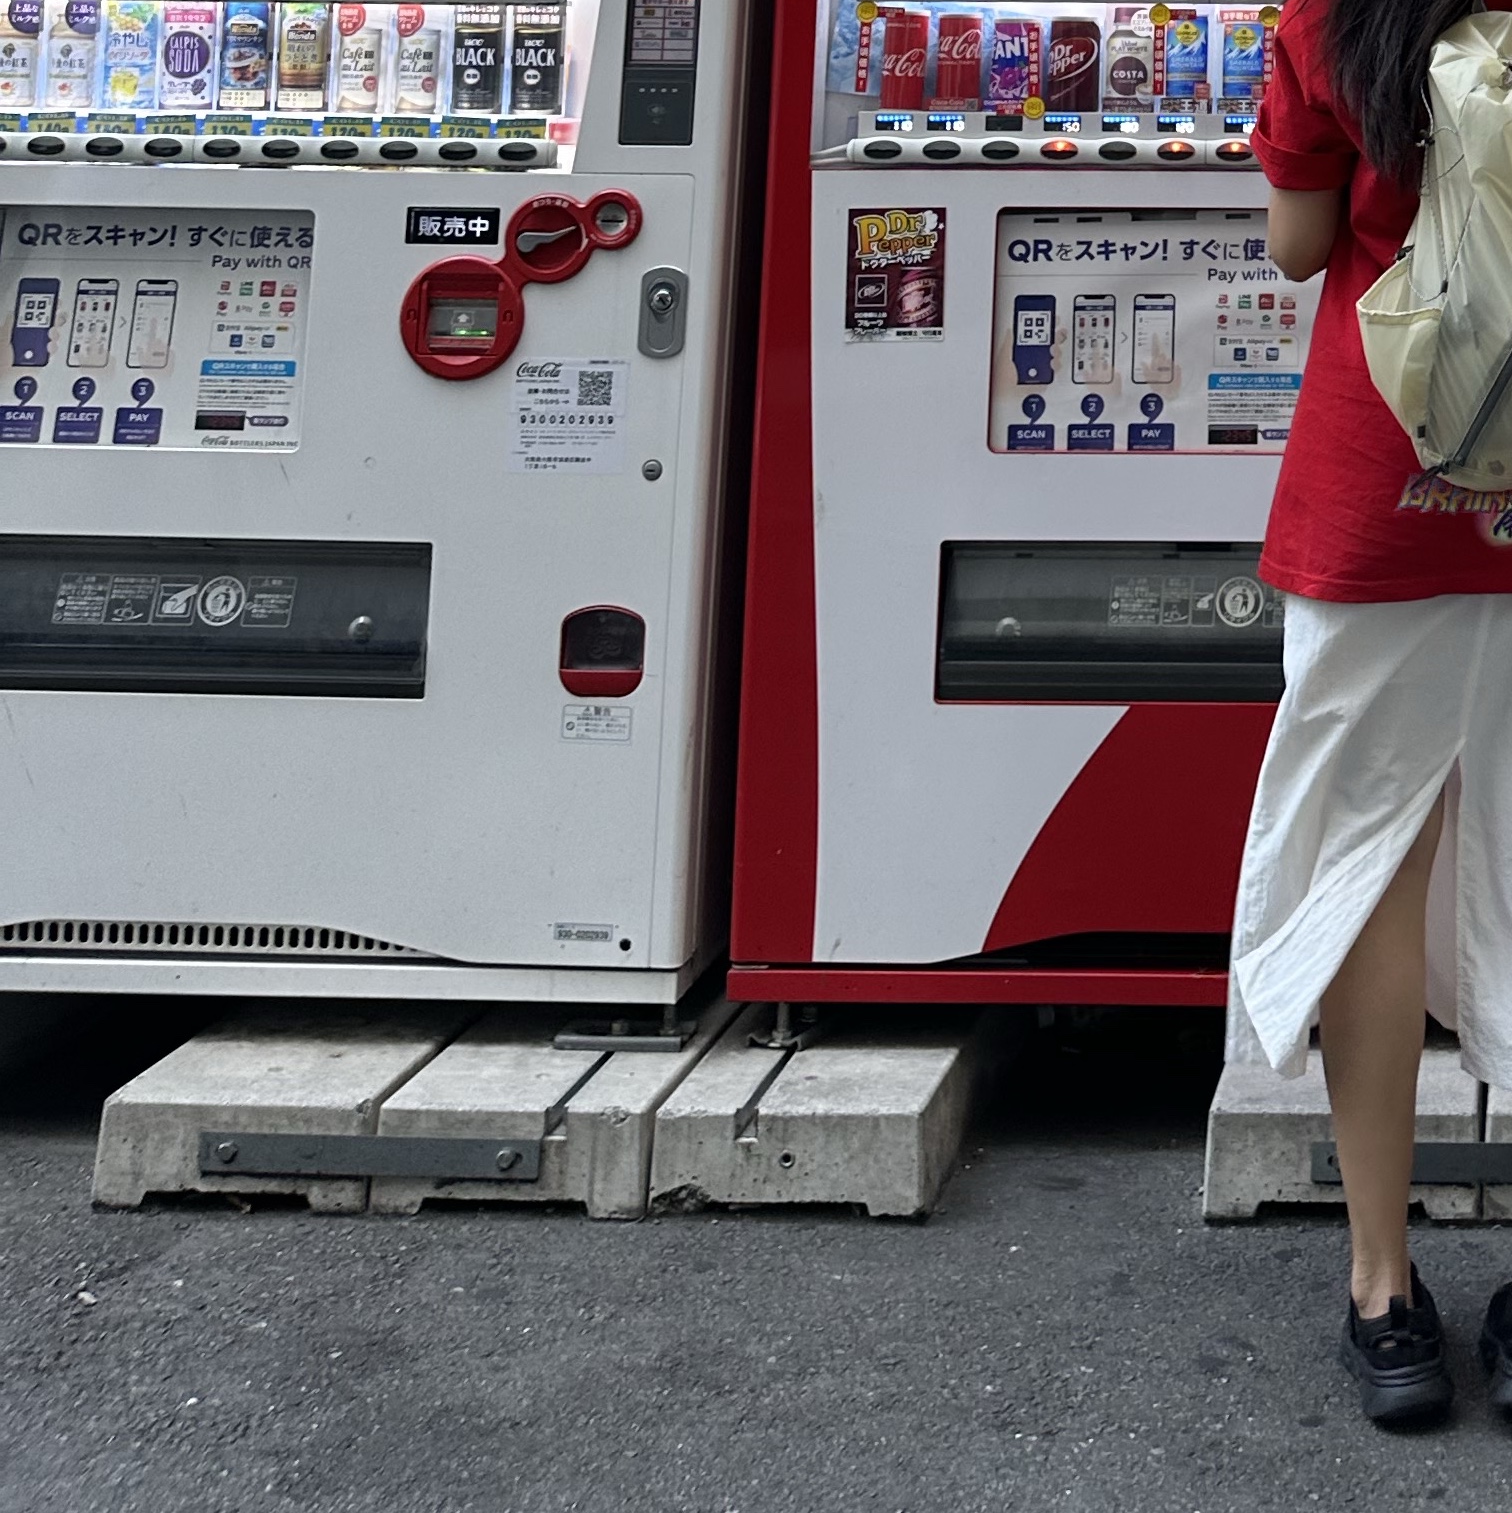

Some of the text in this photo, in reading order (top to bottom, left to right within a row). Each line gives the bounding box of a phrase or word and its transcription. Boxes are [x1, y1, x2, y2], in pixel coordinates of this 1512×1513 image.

[110, 33, 149, 48] 冷やし
[169, 37, 200, 50] CALPIS
[342, 48, 363, 61] Café
[456, 48, 495, 66] BLACK
[515, 48, 556, 67] BLACK
[1053, 43, 1073, 59] Dr
[169, 50, 200, 73] SODA
[1112, 70, 1144, 79] COSTA
[418, 216, 490, 237] 販売中
[887, 211, 924, 235] Dr
[18, 223, 177, 247] QRをスキャン!
[854, 215, 937, 258] Pepper
[1008, 238, 1271, 263] QRをスキャン! すぐに使
[211, 255, 312, 271] Pay with QR
[861, 254, 932, 270] ドクターペッパー
[1207, 268, 1278, 284] Pay with
[516, 361, 564, 378] Coca-Cola
[5, 411, 36, 422] SCAN
[59, 411, 99, 422] SELECT
[129, 413, 149, 423] PAY
[1017, 429, 1046, 438] SCAN
[1071, 429, 1111, 438] SELECT
[1141, 429, 1161, 438] PAY
